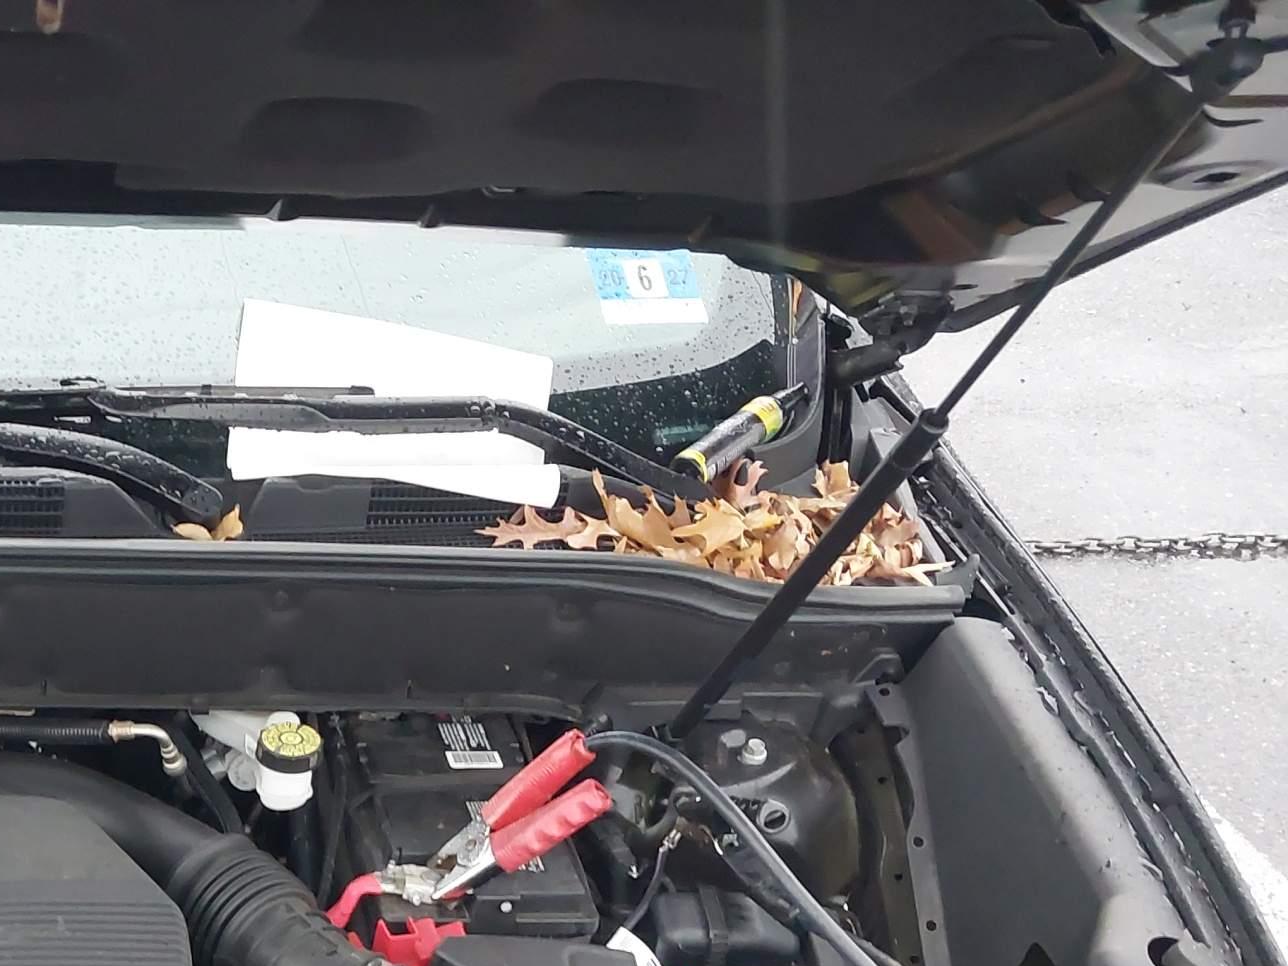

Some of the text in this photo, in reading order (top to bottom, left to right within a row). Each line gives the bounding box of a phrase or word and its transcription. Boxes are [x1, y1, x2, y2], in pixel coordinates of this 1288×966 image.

[601, 265, 689, 291] 20 6 27
